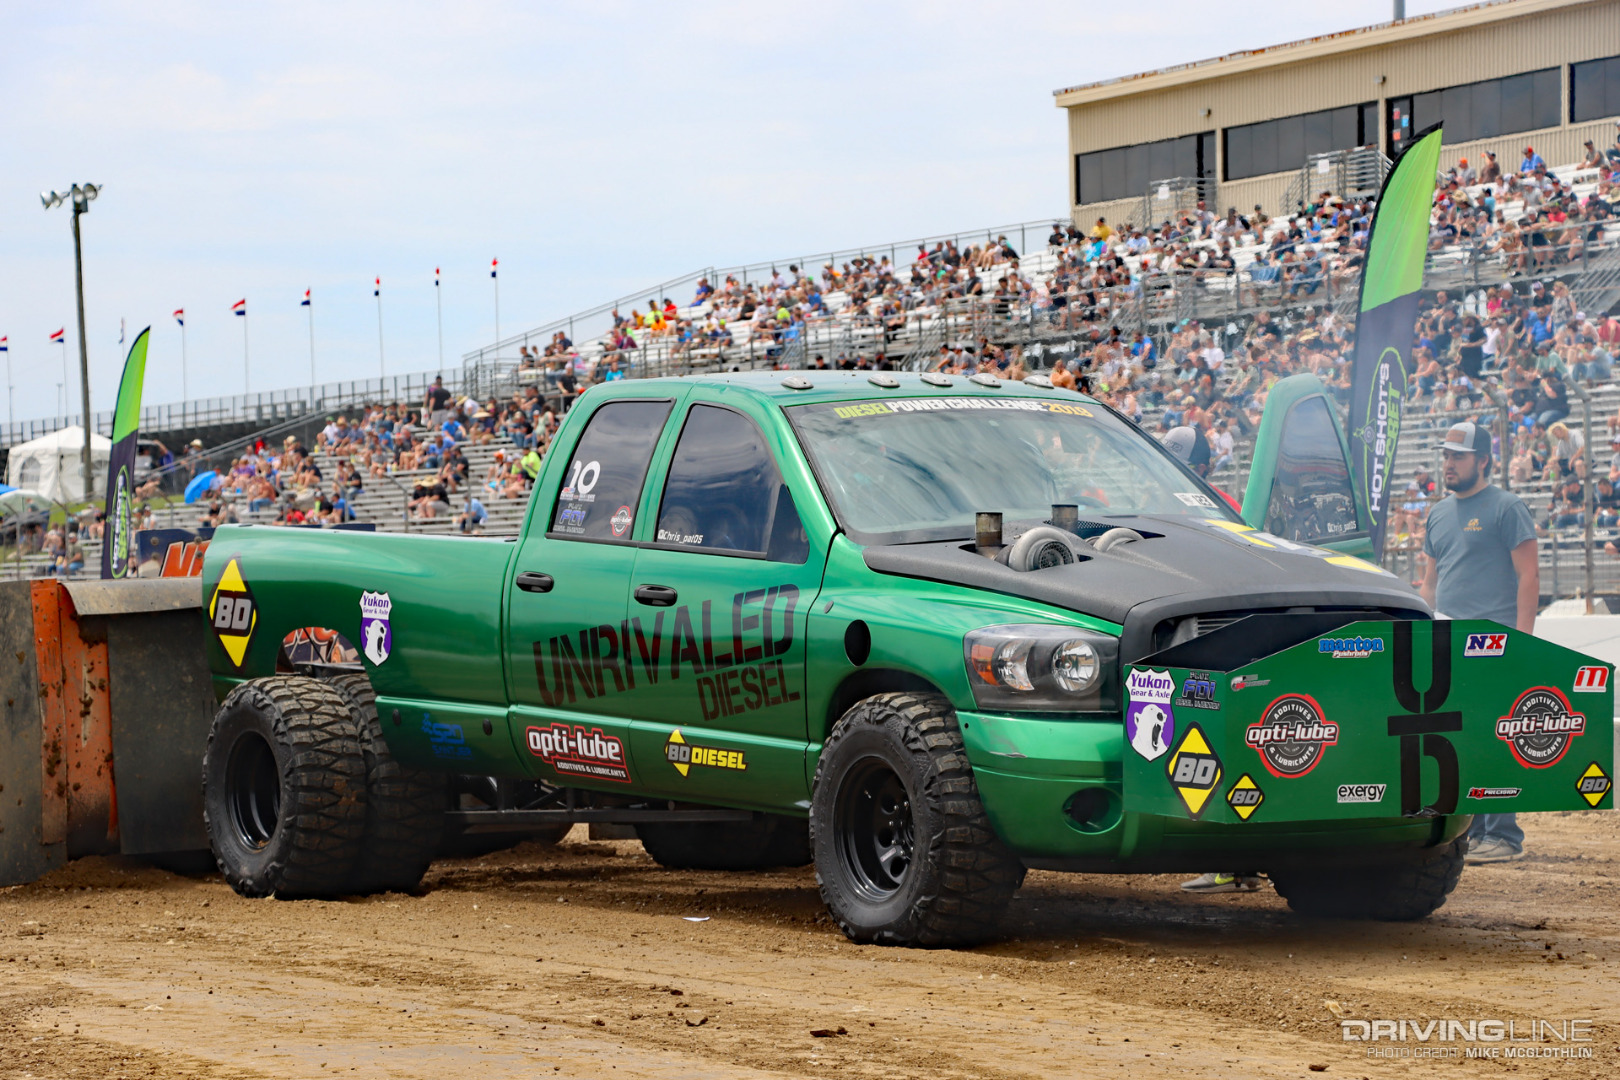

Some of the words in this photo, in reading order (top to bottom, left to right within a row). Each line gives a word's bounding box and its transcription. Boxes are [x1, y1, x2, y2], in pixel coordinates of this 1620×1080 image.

[833, 402, 893, 419] DIESEL
[885, 400, 950, 412] POWER
[945, 399, 1048, 412] CHALLENGE
[1374, 362, 1391, 456] SHOT'S
[569, 460, 601, 494] 10
[1371, 458, 1385, 512] HOT
[363, 595, 389, 608] Yukon
[215, 596, 252, 631] BD
[532, 583, 800, 707] UNRIVALED
[1318, 636, 1384, 652] manton
[1467, 635, 1506, 650] NX
[696, 659, 801, 721] DIESEL
[1131, 673, 1171, 689] Yukon
[1130, 689, 1147, 697] Gear
[1155, 690, 1170, 699] Axle
[1273, 704, 1312, 720] ADDITIVES
[1522, 696, 1560, 713] ADDITIVES
[1248, 723, 1337, 745] opti-lube
[1498, 714, 1583, 738] opti-lube
[528, 728, 621, 760] opti-lube
[1518, 738, 1525, 746] &
[1523, 736, 1562, 757] LUBRICANTS
[1269, 746, 1276, 754] &
[1274, 745, 1315, 767] LUBRICANTS
[556, 761, 586, 772] ADDITIVES
[585, 765, 592, 773] &
[591, 767, 626, 778] LUBRICANTS
[1173, 757, 1217, 785] BD
[1338, 785, 1385, 801] exergy
[1580, 778, 1608, 792] BD
[1231, 790, 1260, 804] BD
